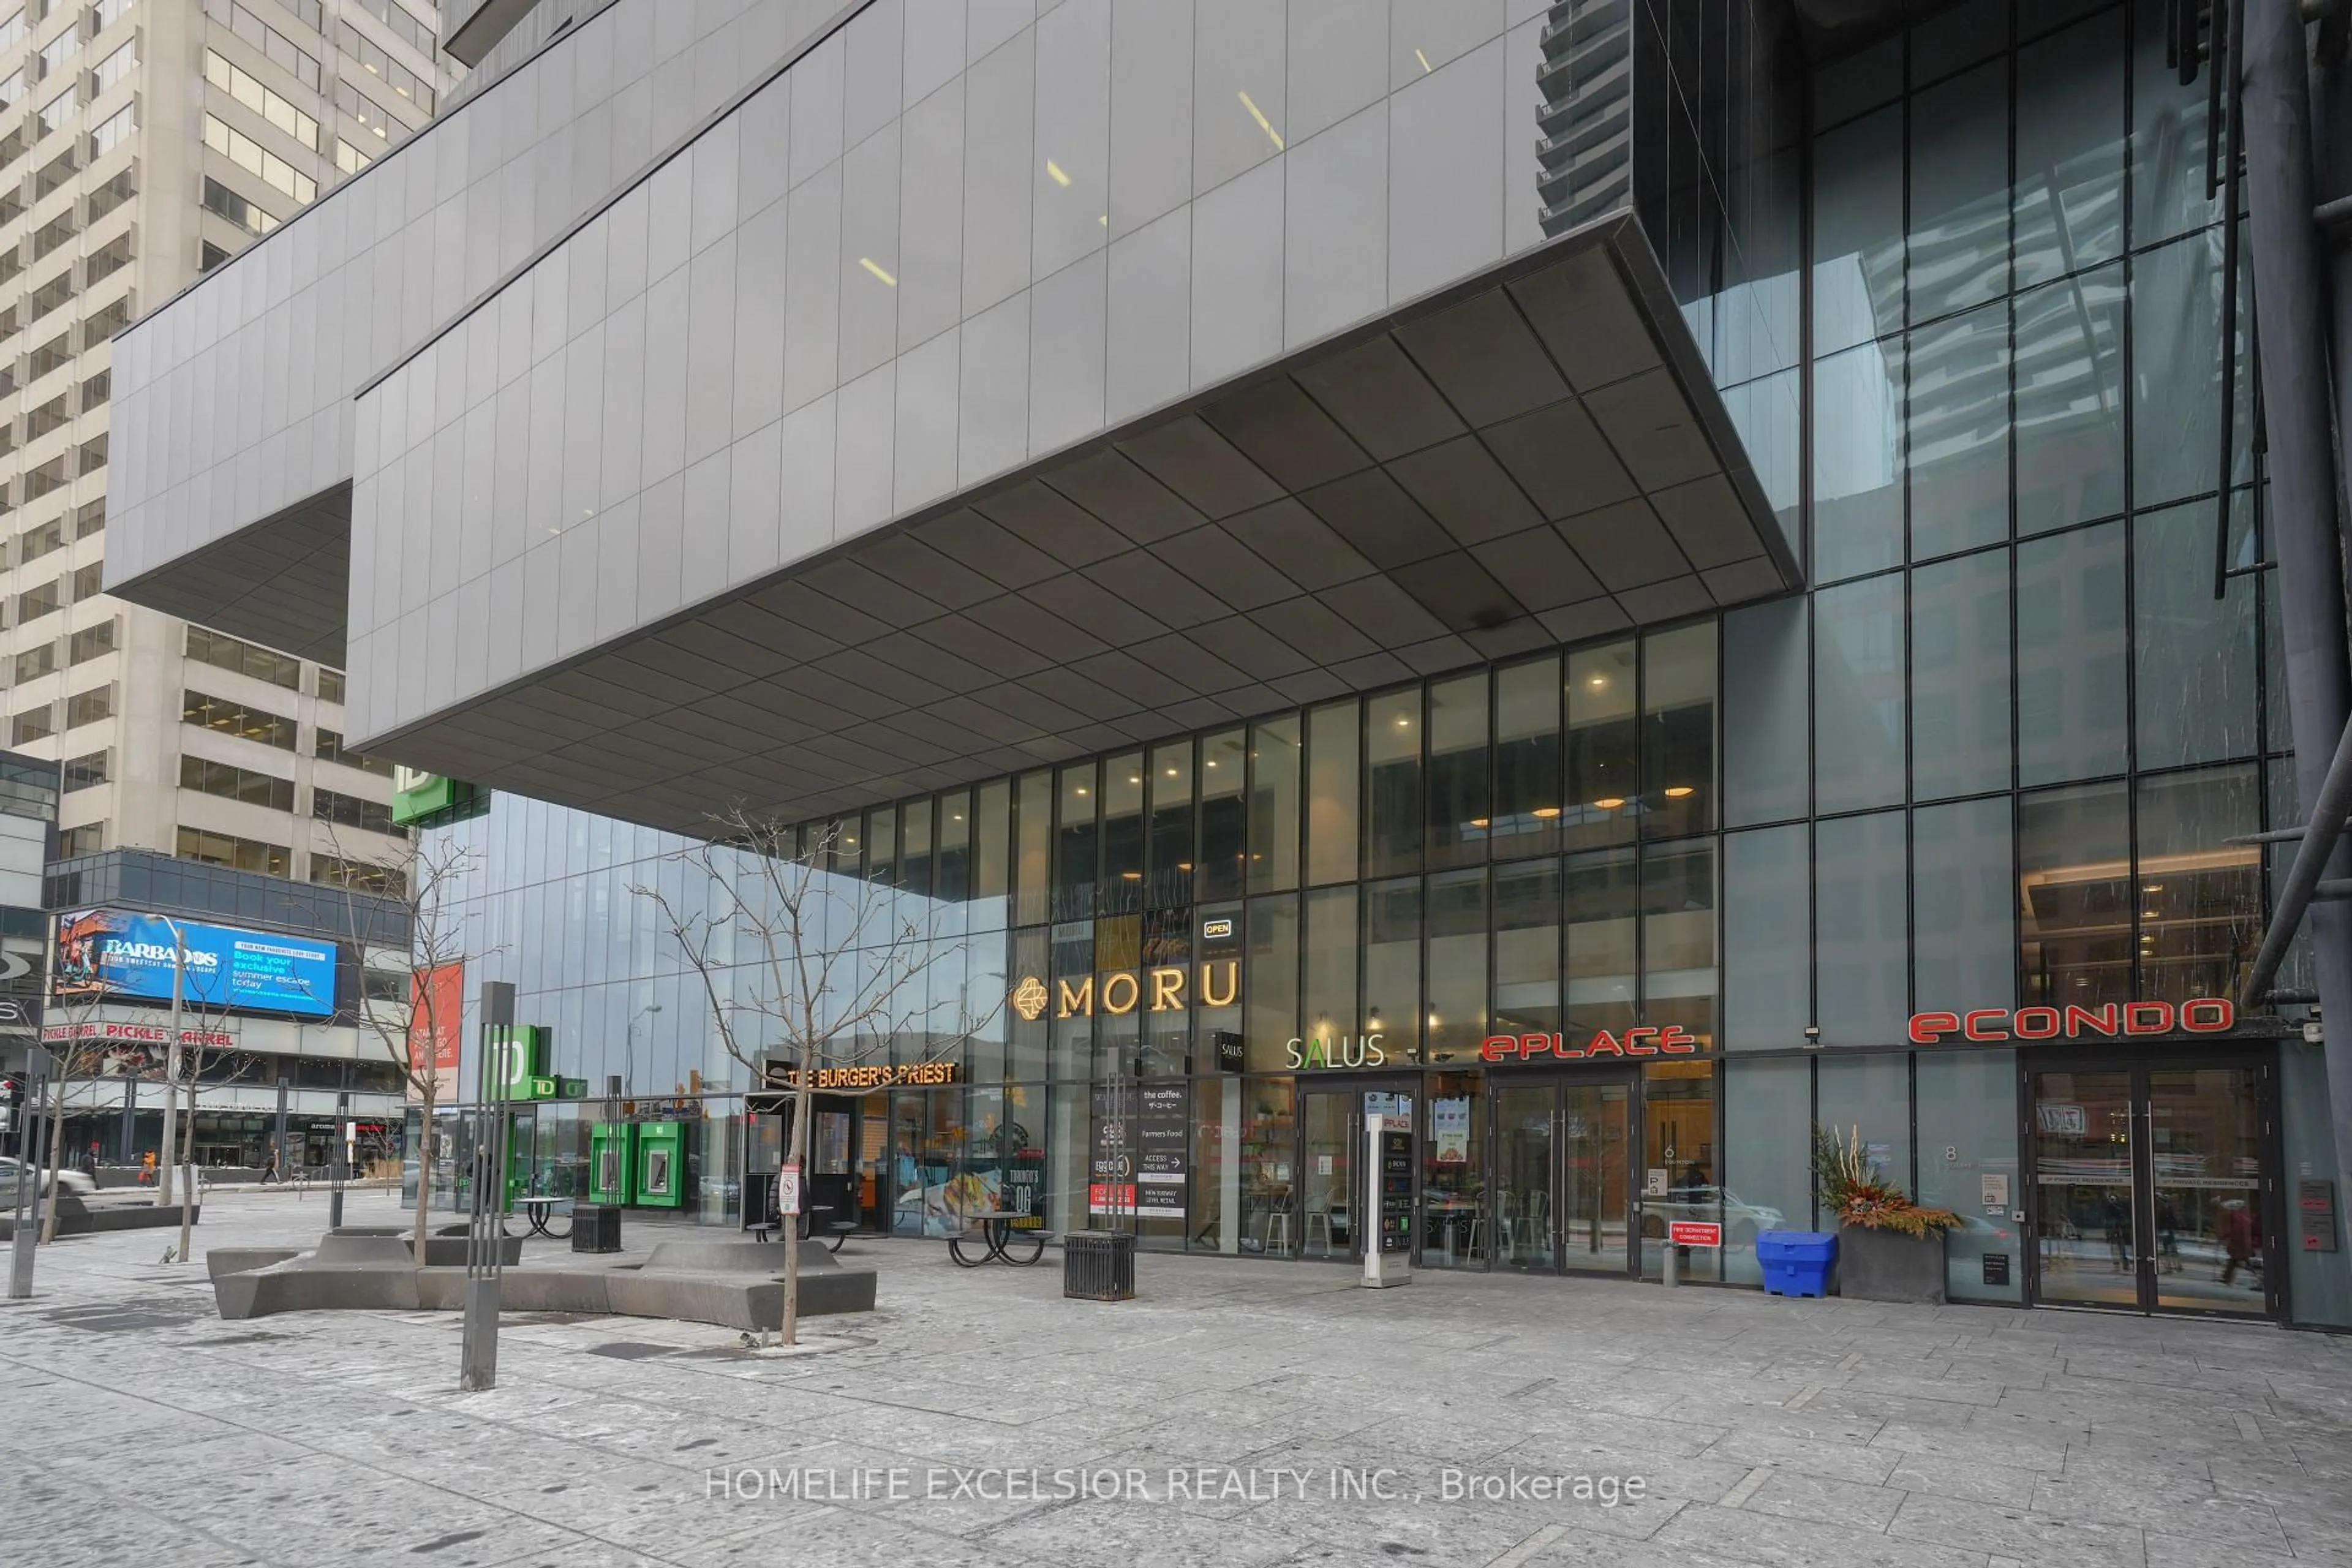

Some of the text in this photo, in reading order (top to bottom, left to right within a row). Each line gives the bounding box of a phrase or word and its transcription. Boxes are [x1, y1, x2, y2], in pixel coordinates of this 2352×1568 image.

[1207, 925, 1229, 934] OPEN
[234, 951, 292, 965] Book your
[233, 961, 285, 974] exclusive
[232, 978, 262, 989] today
[233, 970, 311, 986] summer escape
[1057, 961, 1237, 1019] MORU
[43, 1027, 67, 1040] PICKLE
[106, 1025, 233, 1046] PICKLE ARREL
[1222, 1044, 1243, 1057] SALUS
[1286, 1034, 1384, 1069] SALUS
[818, 1066, 892, 1087] BURGER'S
[897, 1063, 955, 1084] PRIEST
[533, 1079, 555, 1095] TD
[1665, 1145, 1675, 1158] 6
[1945, 1146, 1956, 1161] 8
[1016, 1185, 1031, 1213] OG
